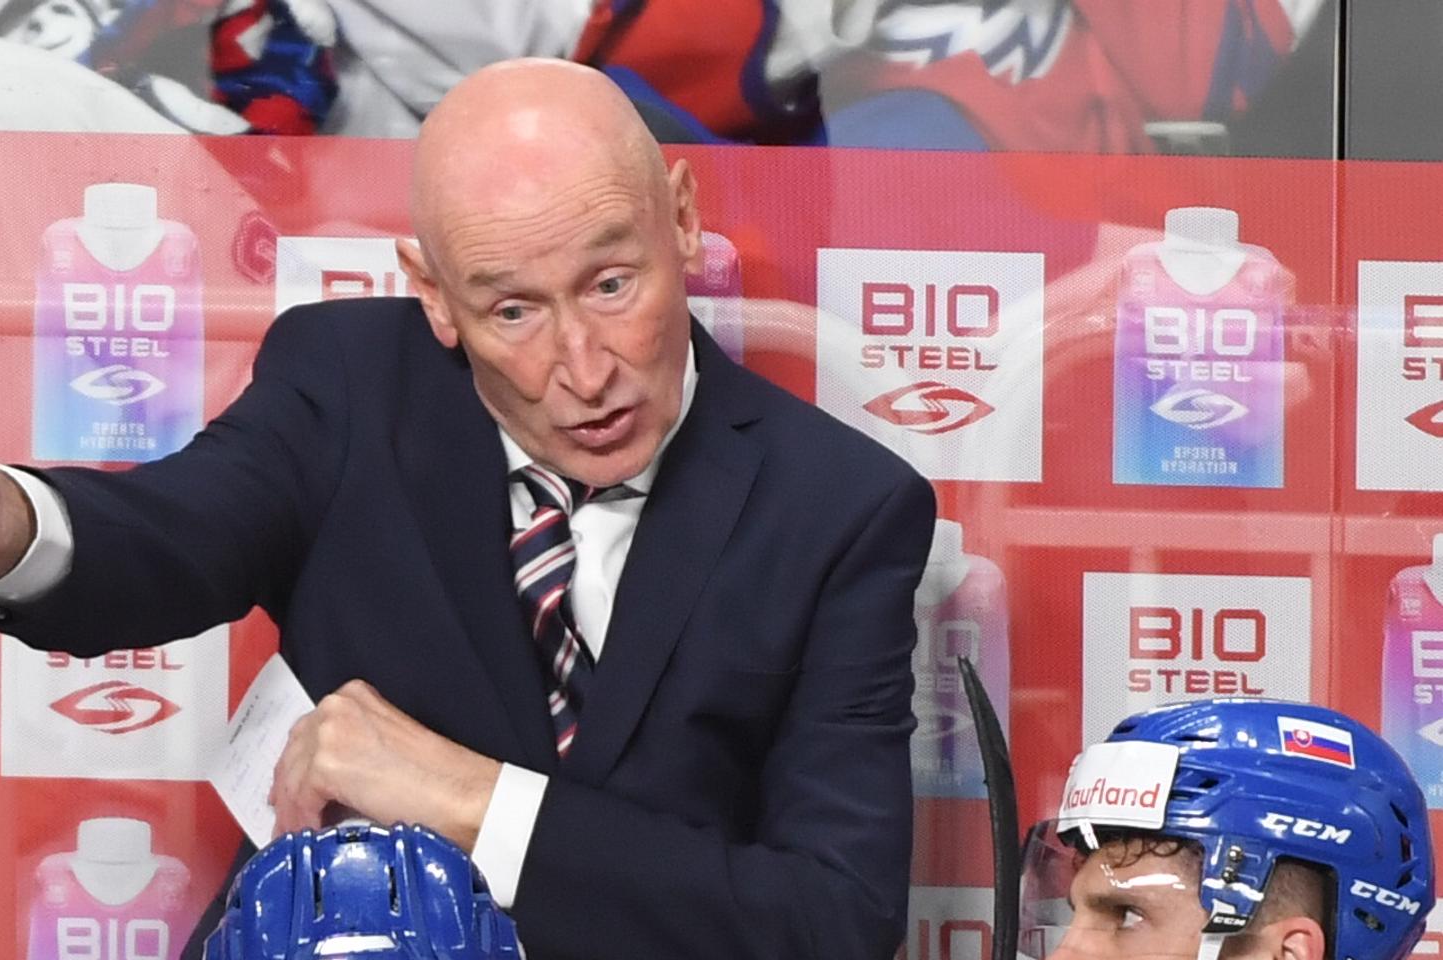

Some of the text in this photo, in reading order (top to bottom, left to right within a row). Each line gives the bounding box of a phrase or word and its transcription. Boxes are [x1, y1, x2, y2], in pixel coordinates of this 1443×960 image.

[62, 282, 175, 332] BIO
[862, 282, 999, 337] BIO
[65, 336, 170, 358] STEEL
[1145, 307, 1257, 356] BIO
[861, 345, 997, 370] STEEL
[1147, 361, 1252, 382] STEEL
[912, 619, 980, 669] IO
[1129, 607, 1267, 663] BIO
[1128, 669, 1264, 694] STEEL
[1259, 812, 1354, 845] CCM
[1350, 879, 1421, 916] CCM
